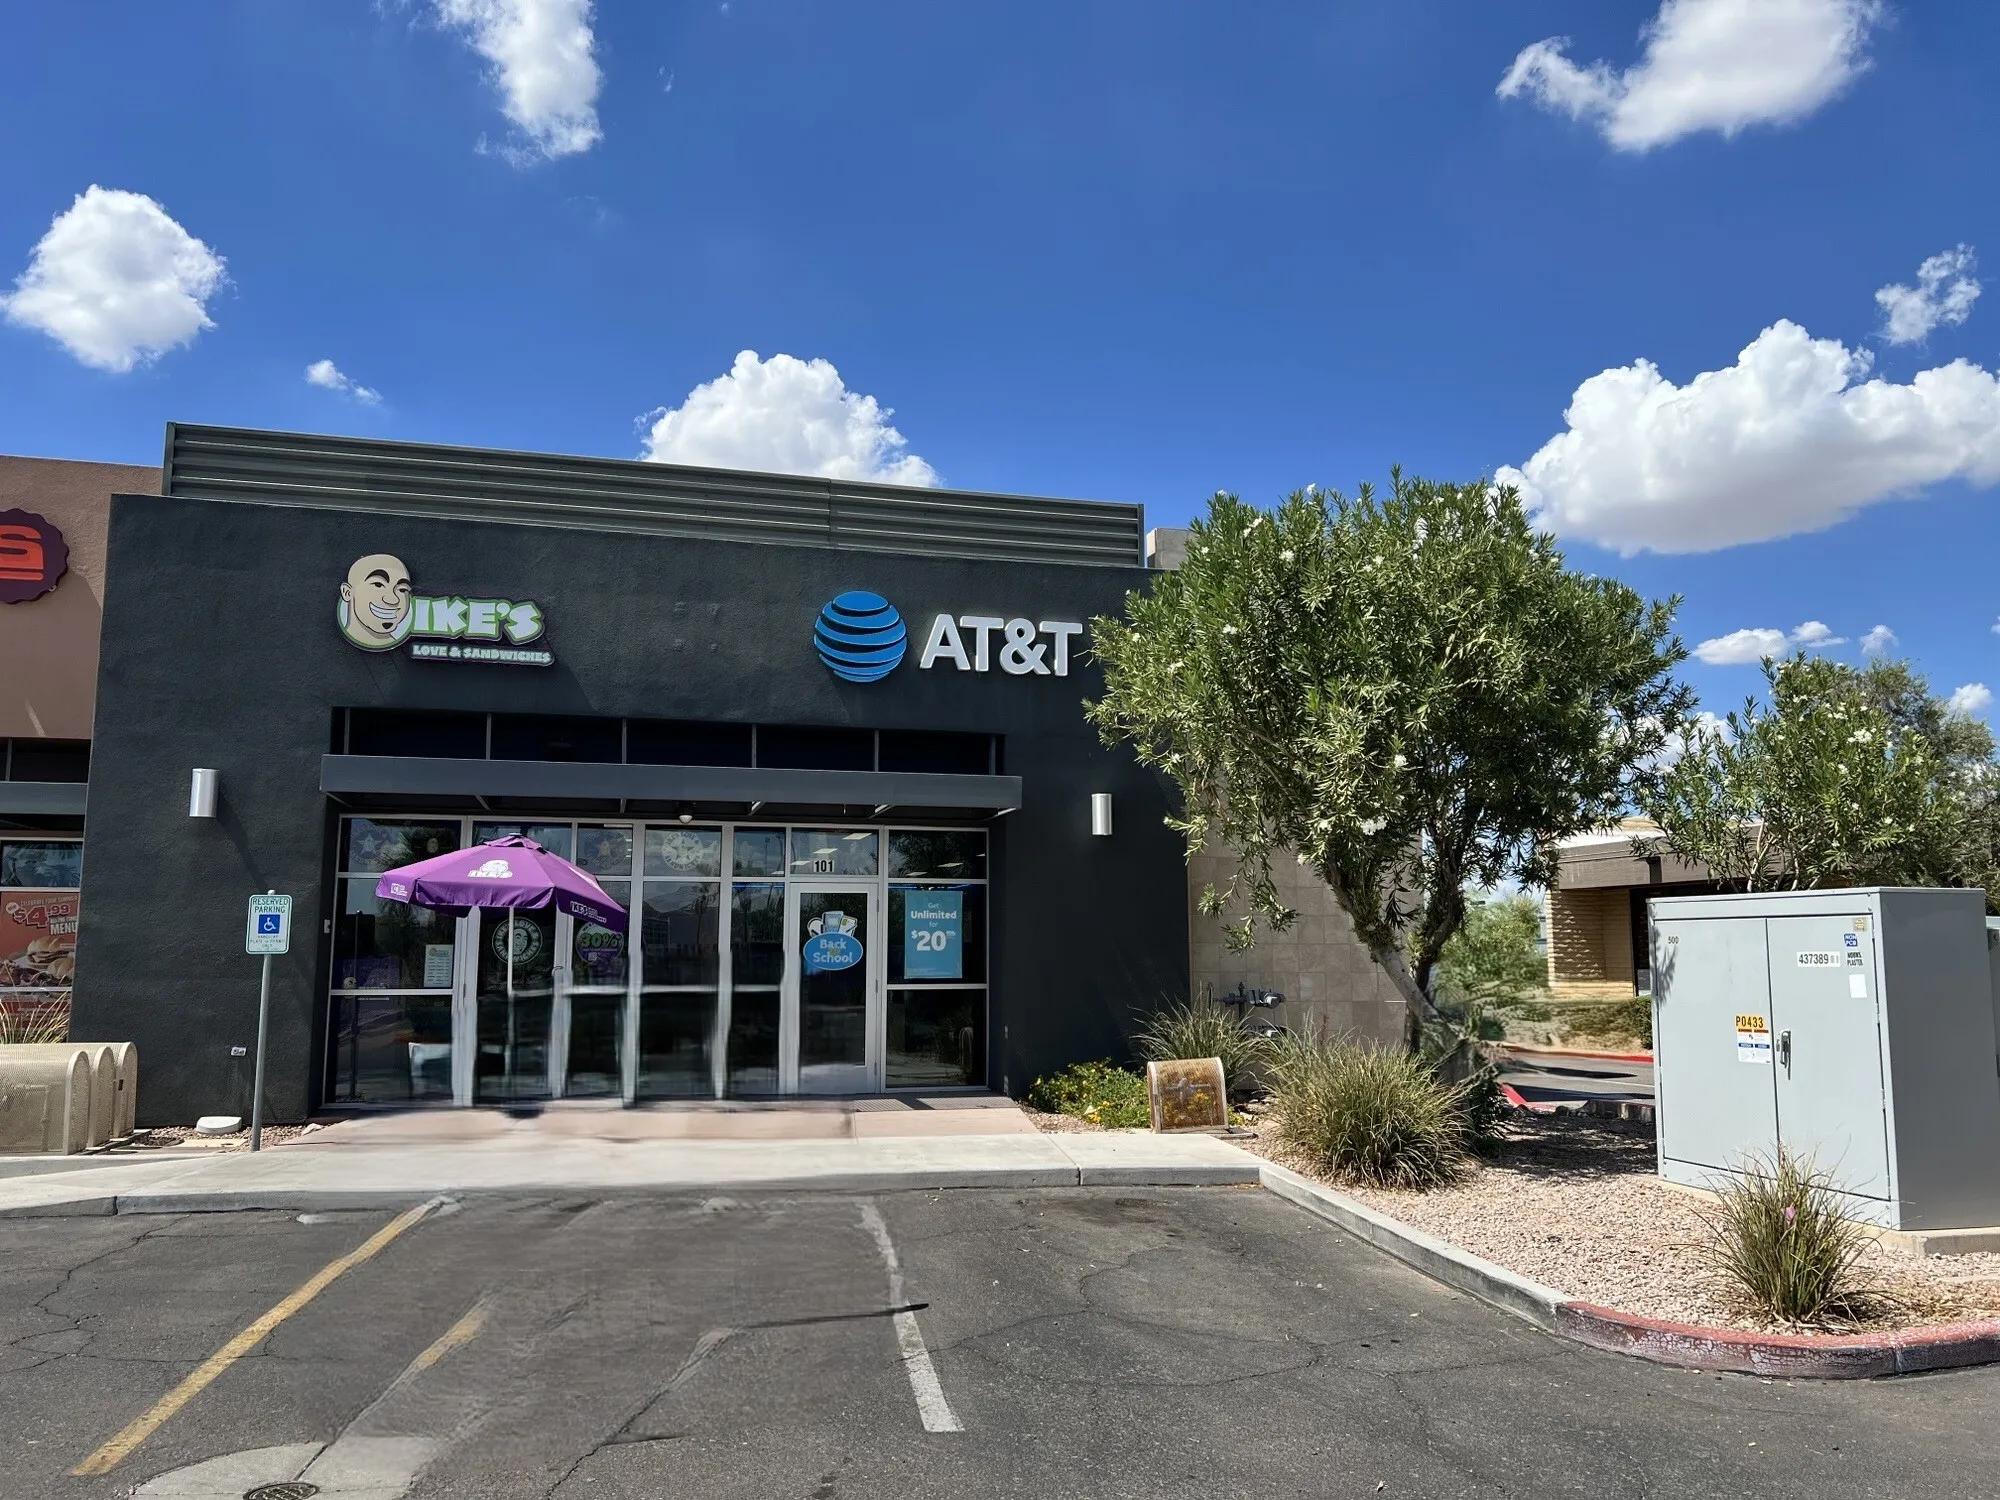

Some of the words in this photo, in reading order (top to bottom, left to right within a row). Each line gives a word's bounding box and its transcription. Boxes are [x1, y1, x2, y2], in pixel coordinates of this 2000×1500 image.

[412, 598, 543, 641] IKE'S
[919, 613, 1083, 676] AT&T
[413, 645, 449, 656] LOVE
[449, 647, 461, 657] &
[463, 647, 551, 662] SANDWICHES
[815, 860, 833, 872] 101
[252, 897, 289, 905] RESERVED
[910, 910, 957, 919] Unlimited
[820, 939, 847, 949] Back
[1668, 936, 1680, 945] 500
[813, 951, 853, 963] School
[1799, 953, 1829, 965] 437389
